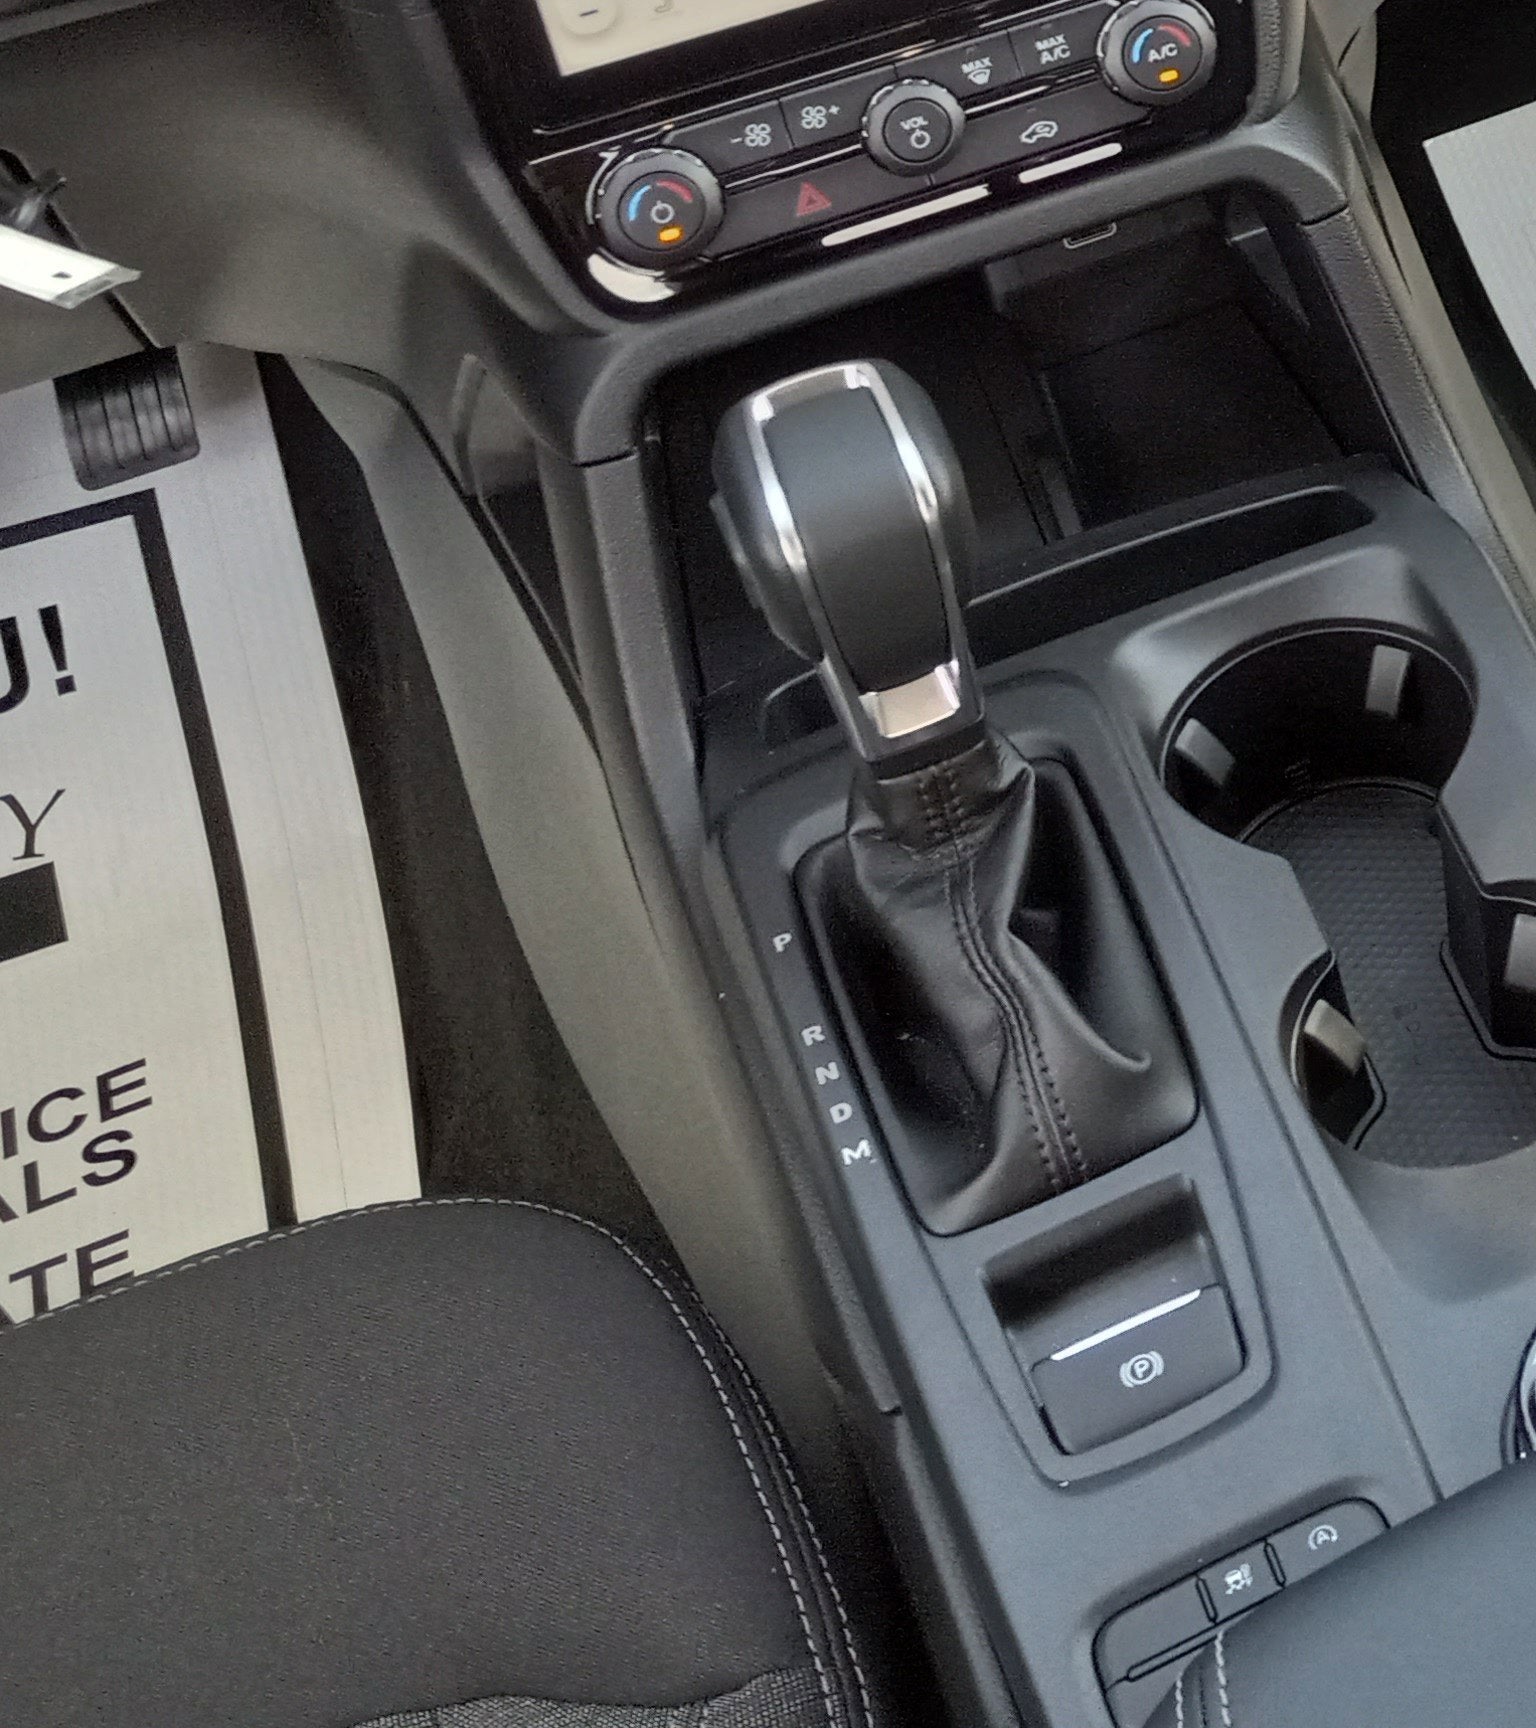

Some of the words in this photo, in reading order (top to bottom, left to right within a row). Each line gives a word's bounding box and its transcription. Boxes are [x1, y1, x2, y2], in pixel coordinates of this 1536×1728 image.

[1034, 33, 1067, 52] MAX
[1147, 42, 1179, 63] A/C
[960, 55, 993, 74] MAX
[1040, 45, 1072, 65] A/C
[899, 115, 929, 131] VOL
[772, 932, 793, 953] P
[801, 1024, 826, 1046] R
[814, 1061, 840, 1085] N
[0, 1057, 153, 1160] ICE
[828, 1103, 854, 1125] D
[841, 1139, 872, 1165] M
[0, 1228, 135, 1327] TE
